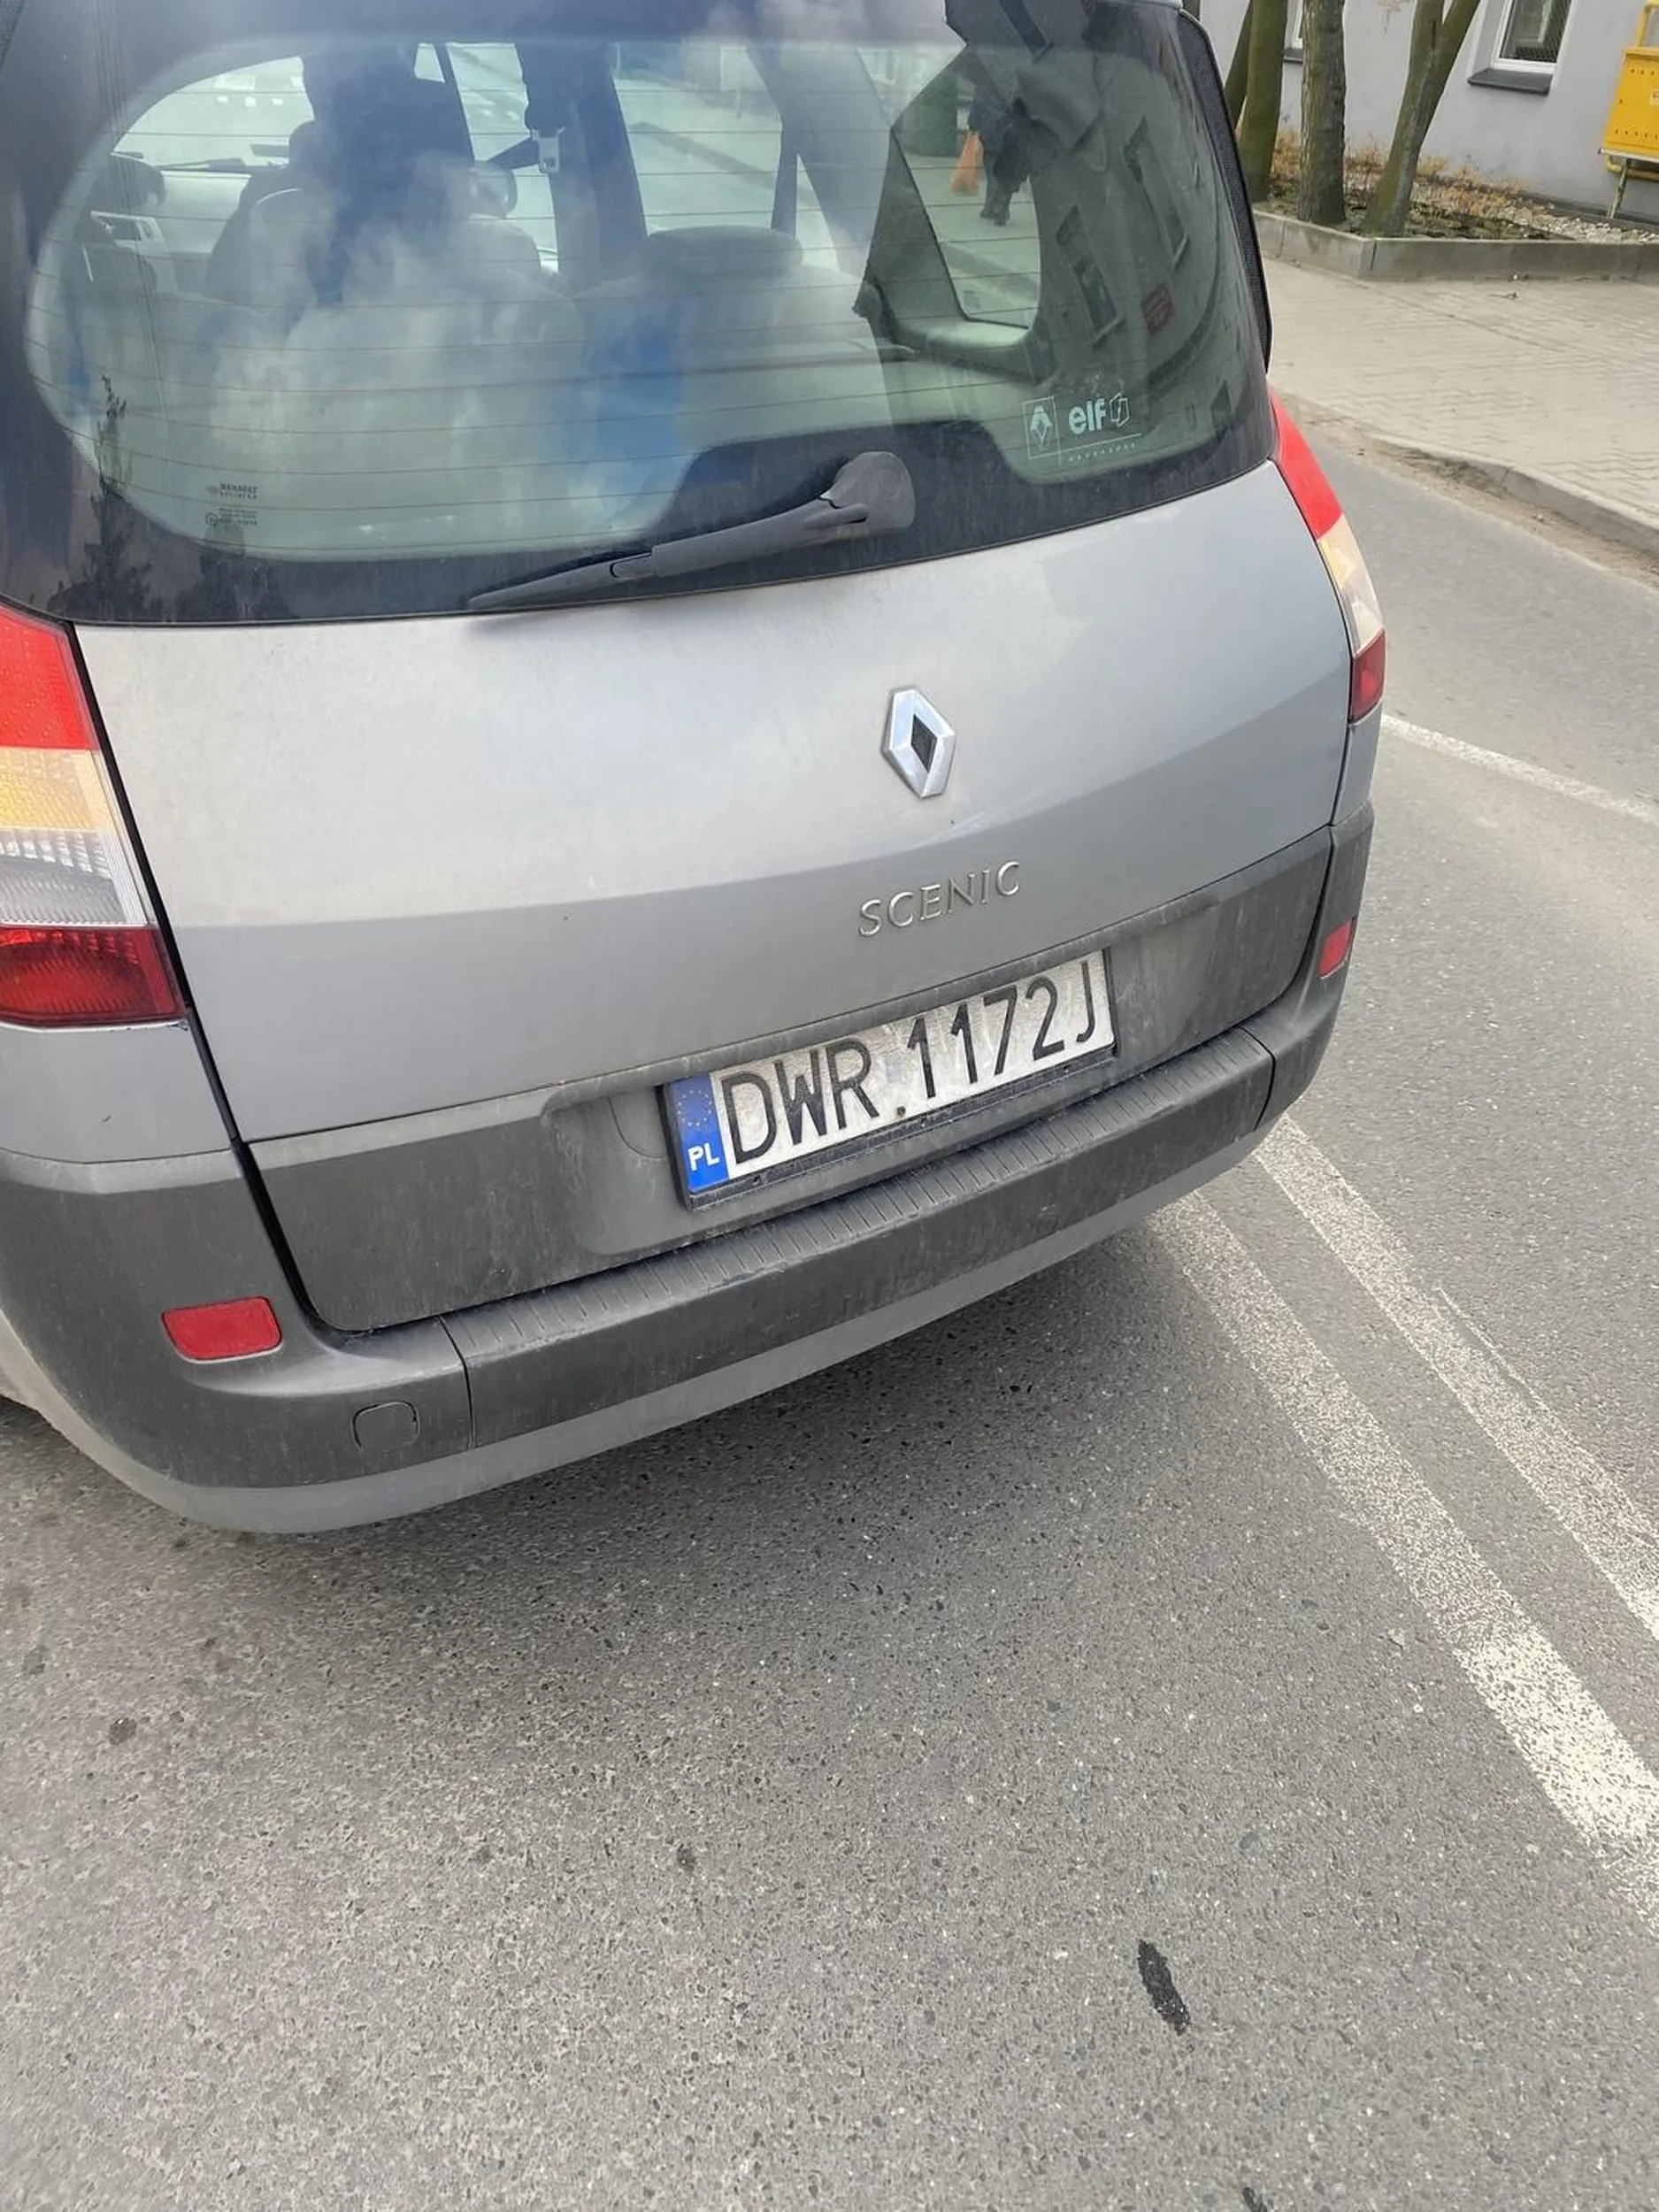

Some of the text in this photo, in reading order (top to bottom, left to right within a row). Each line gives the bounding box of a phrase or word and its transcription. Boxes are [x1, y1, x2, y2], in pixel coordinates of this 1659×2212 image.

[1068, 398, 1106, 434] elf
[858, 861, 1020, 937] SCENIC
[721, 962, 1096, 1164] DWR 1172J
[687, 1146, 719, 1171] PL
